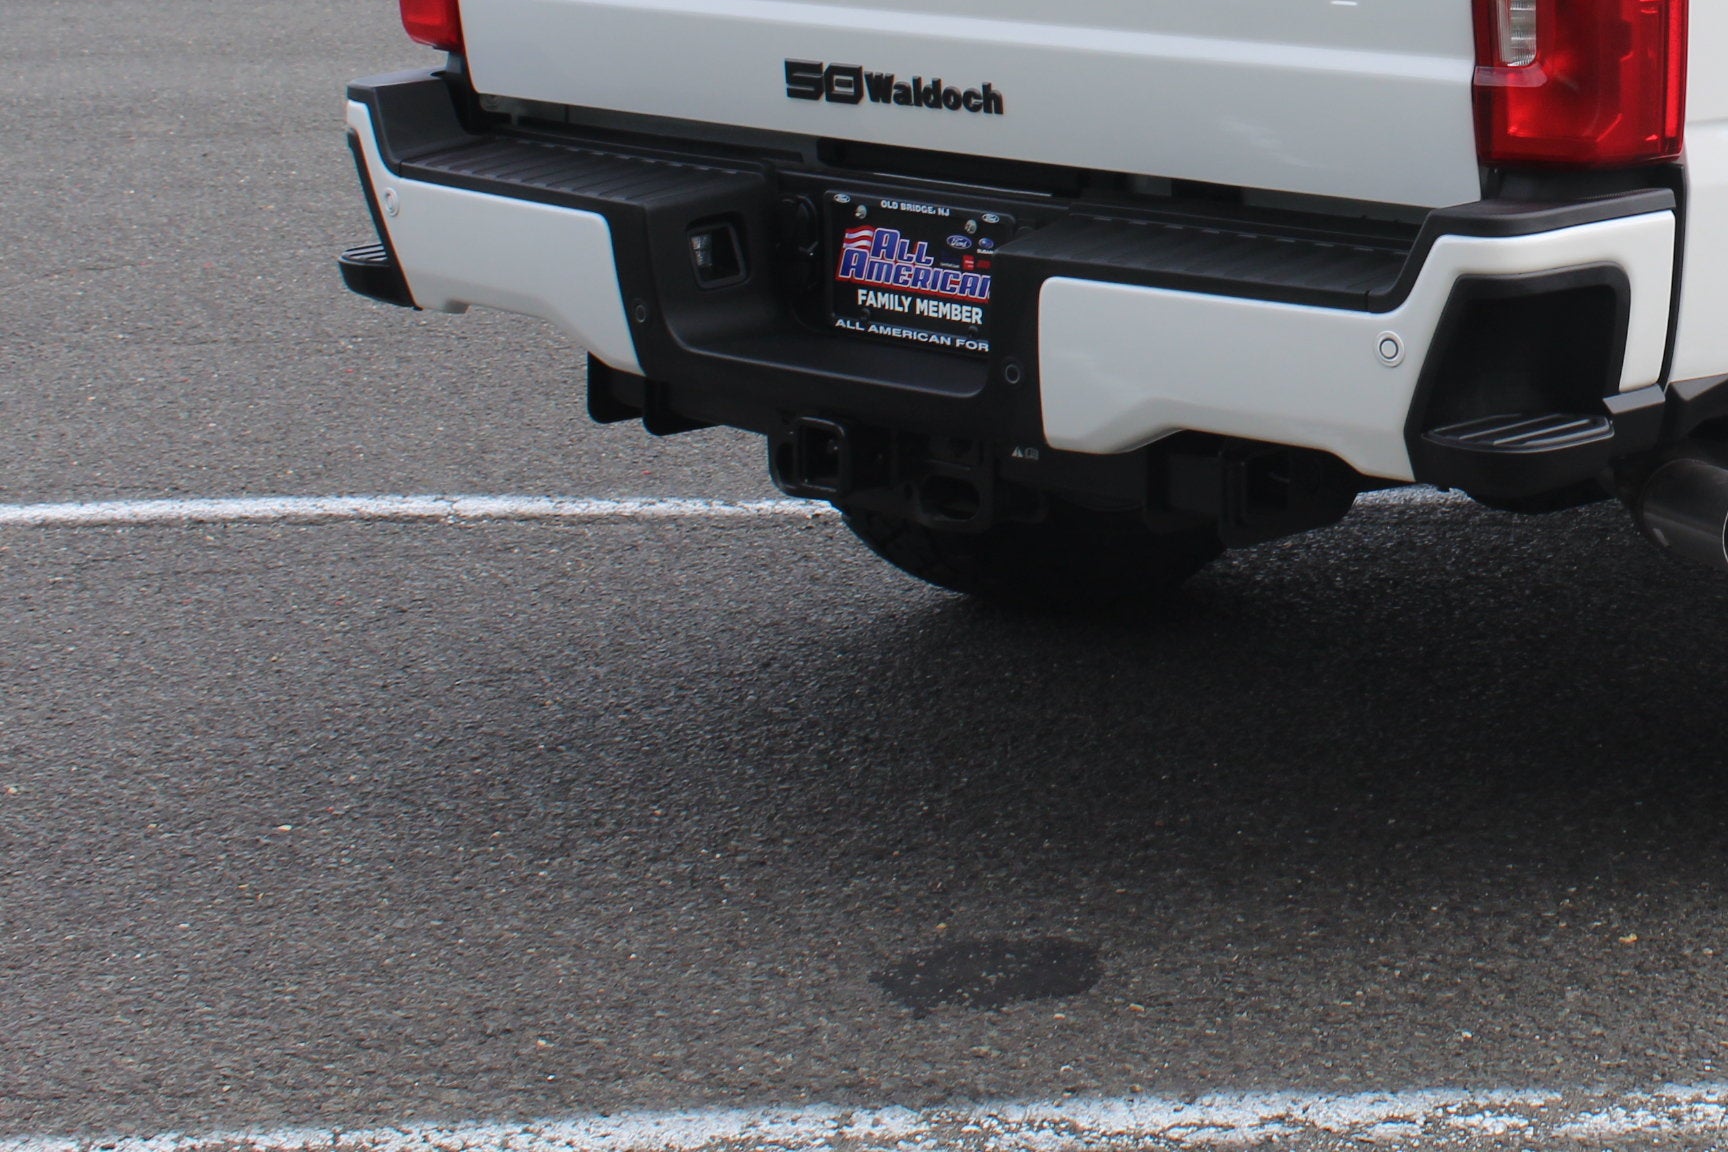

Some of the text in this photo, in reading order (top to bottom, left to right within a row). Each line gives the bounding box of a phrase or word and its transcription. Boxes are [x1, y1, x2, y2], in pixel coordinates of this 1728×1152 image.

[864, 70, 1004, 115] Waldoch
[880, 199, 899, 210] OLD
[937, 205, 950, 217] NJ
[871, 227, 935, 266] ALL
[857, 288, 984, 326] FAMILY MEMBER
[834, 318, 990, 353] ALL AMERICAN FOR
